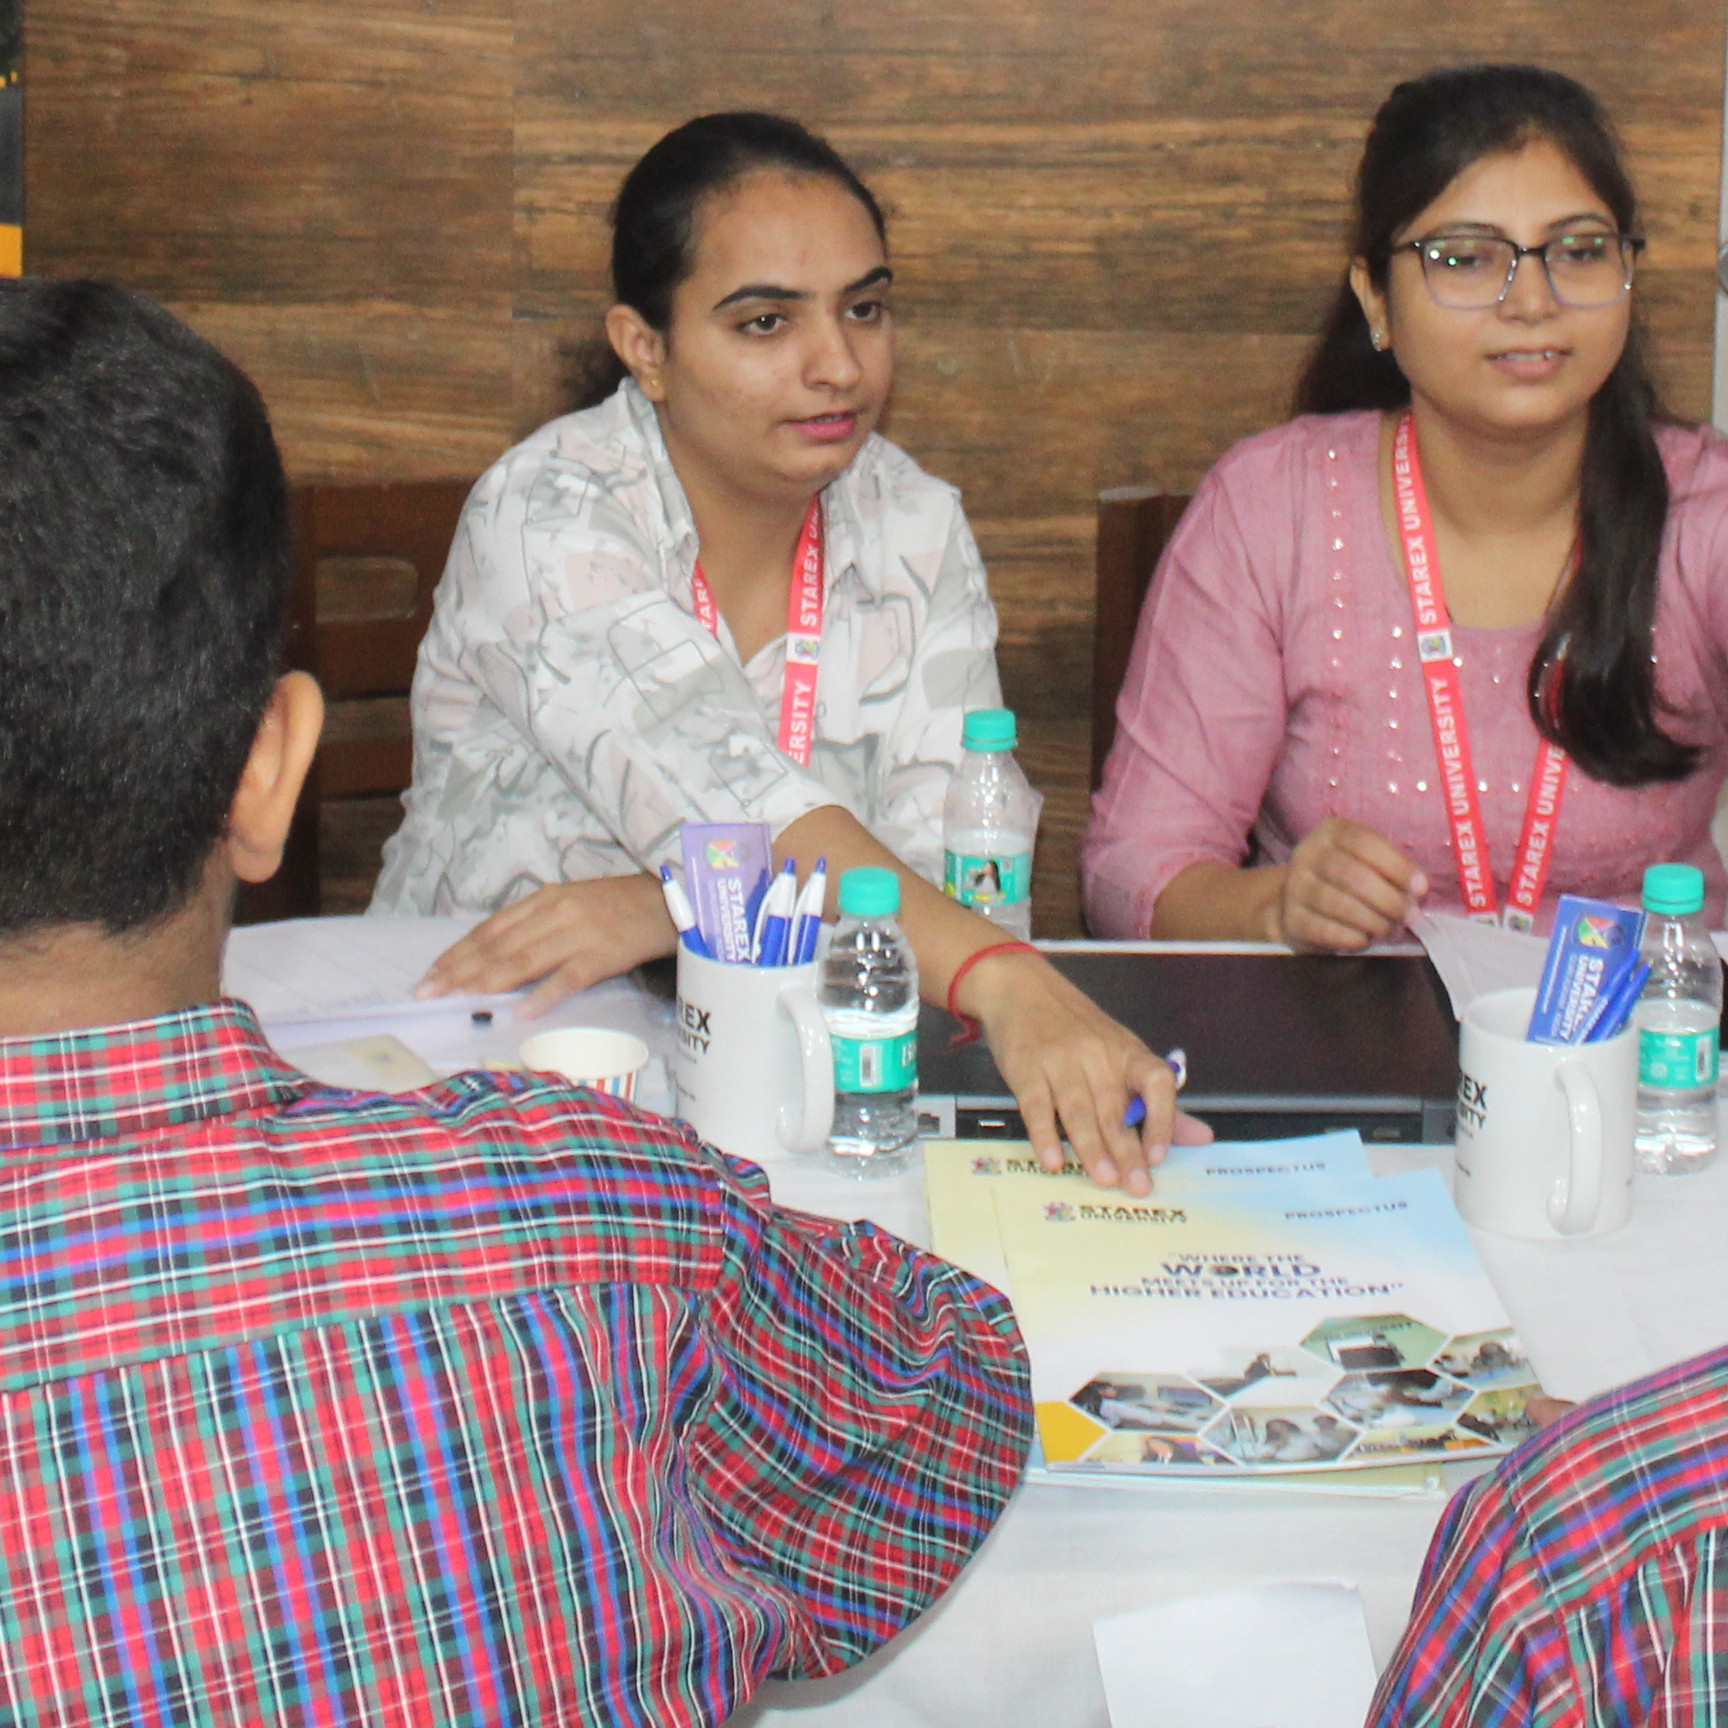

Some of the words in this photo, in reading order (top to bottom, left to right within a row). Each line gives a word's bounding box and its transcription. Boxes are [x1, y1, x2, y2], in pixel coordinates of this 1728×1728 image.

[800, 545, 820, 627] STAREX
[1407, 535, 1439, 625] STAREX
[1429, 676, 1471, 816] UNIVERSITY
[1455, 818, 1487, 908] STAREX
[1516, 820, 1550, 907] STAREX
[727, 877, 751, 962] STAREX
[1079, 1204, 1187, 1219] STAREX
[1089, 1284, 1202, 1299] HIGHER
